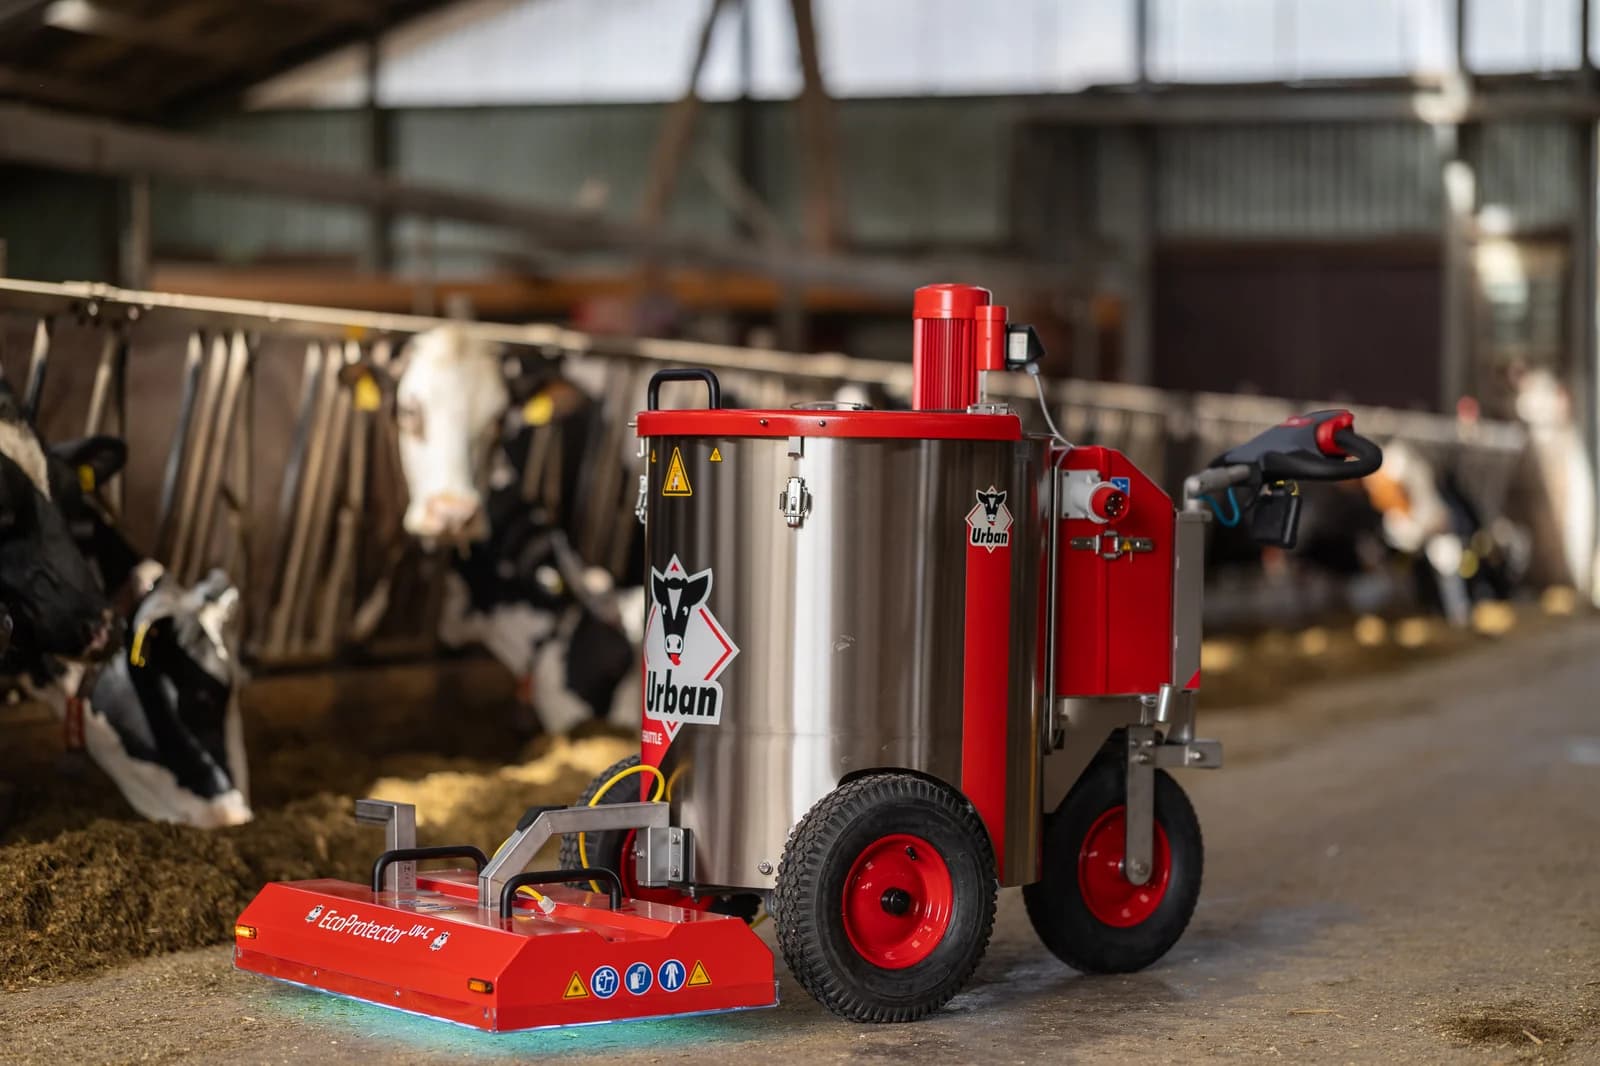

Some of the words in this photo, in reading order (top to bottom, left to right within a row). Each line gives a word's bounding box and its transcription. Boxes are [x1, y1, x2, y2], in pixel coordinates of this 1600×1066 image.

[972, 527, 1008, 543] Urban
[647, 669, 717, 716] Urban
[318, 910, 407, 944] EcoProtector
[408, 923, 434, 939] UV-C
